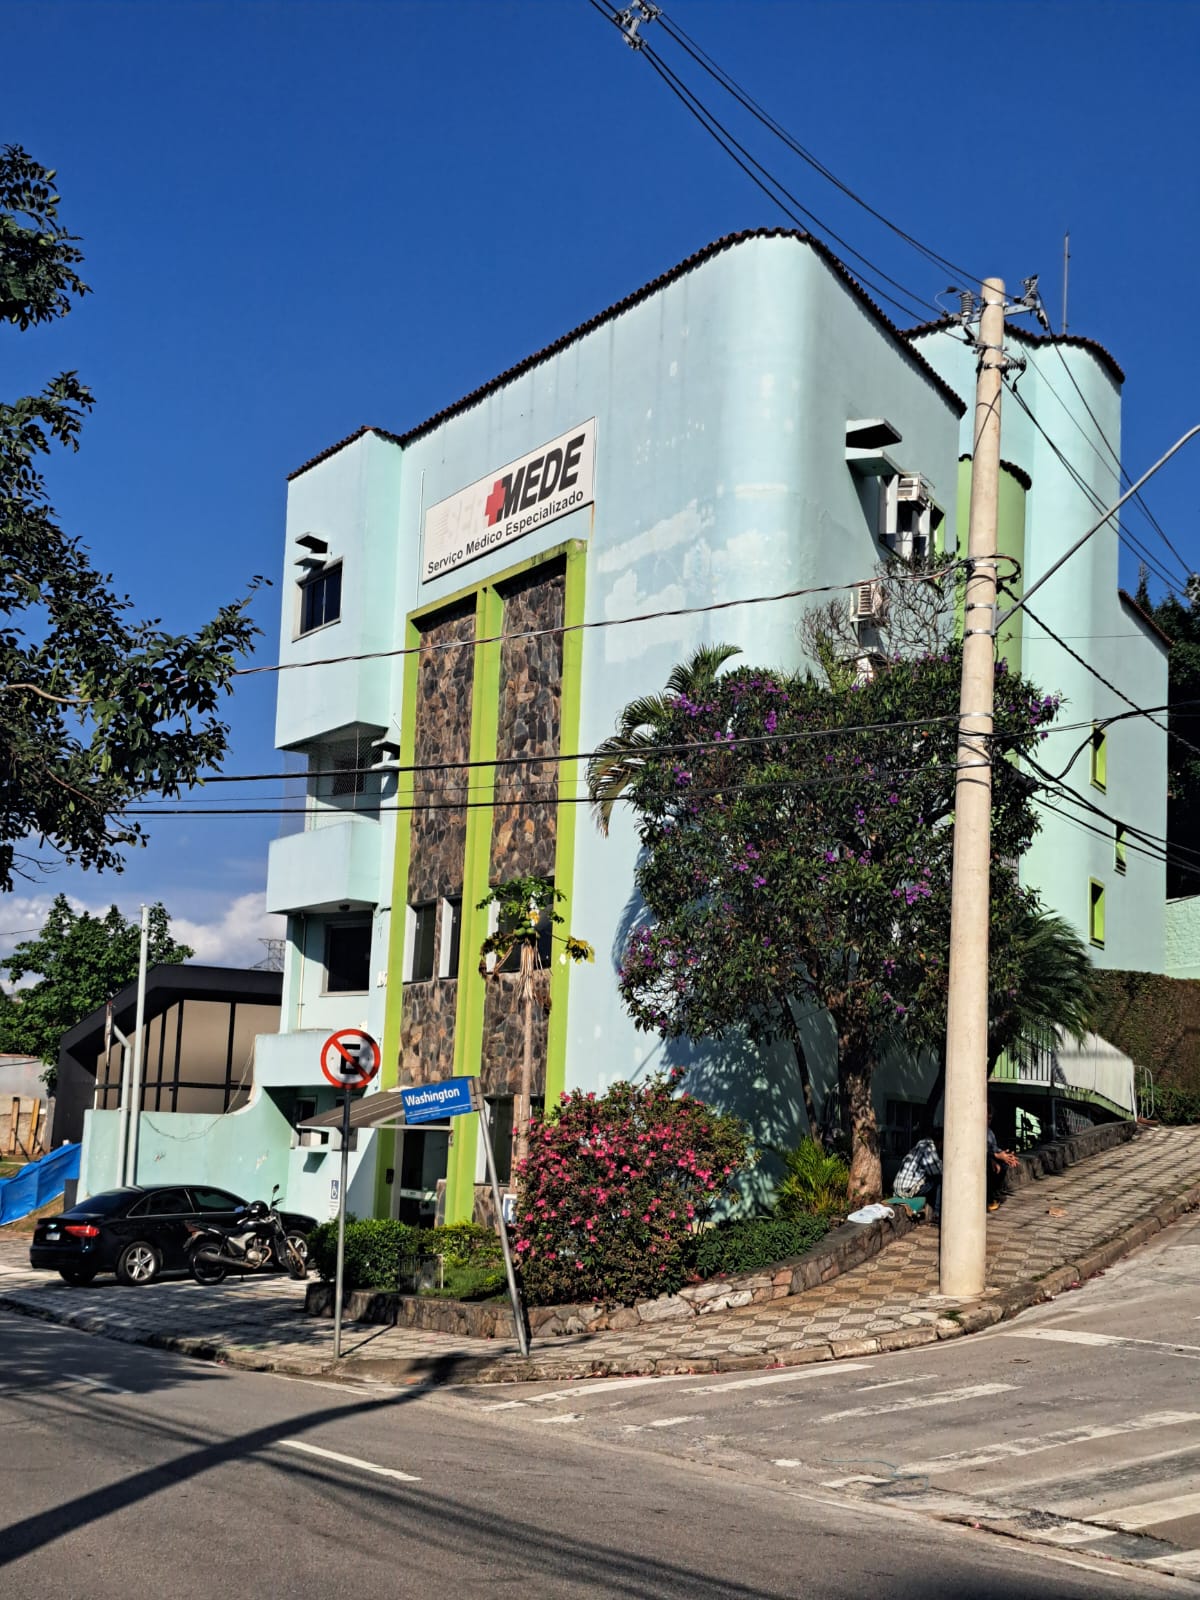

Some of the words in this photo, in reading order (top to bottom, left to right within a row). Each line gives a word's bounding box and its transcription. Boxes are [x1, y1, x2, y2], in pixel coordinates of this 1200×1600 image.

[496, 433, 586, 523] MEDE
[427, 549, 464, 574] Serviço
[466, 530, 503, 556] Médico
[506, 490, 584, 536] Especializado
[340, 1043, 361, 1075] E
[405, 1087, 460, 1107] Washington
